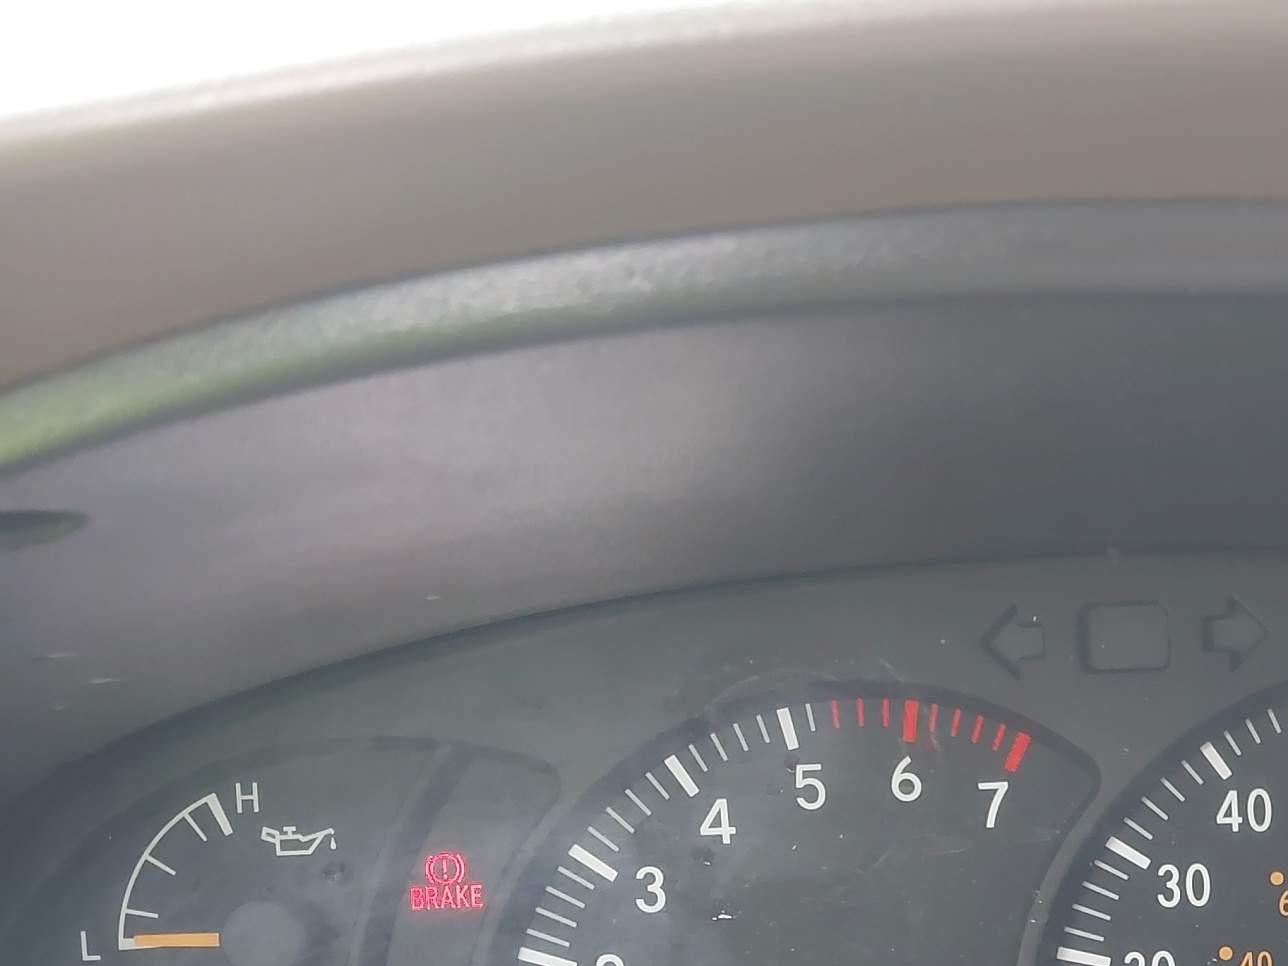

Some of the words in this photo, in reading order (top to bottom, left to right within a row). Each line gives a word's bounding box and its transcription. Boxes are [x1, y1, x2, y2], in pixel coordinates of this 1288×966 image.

[235, 781, 260, 814] H
[795, 763, 826, 810] 5
[891, 755, 922, 802] 6
[699, 798, 737, 845] 4
[977, 781, 1009, 829] 7
[1216, 788, 1272, 833] 40
[410, 884, 484, 911] BRAKE
[635, 866, 667, 913] 3
[1157, 863, 1211, 908] 30
[80, 930, 102, 962] L
